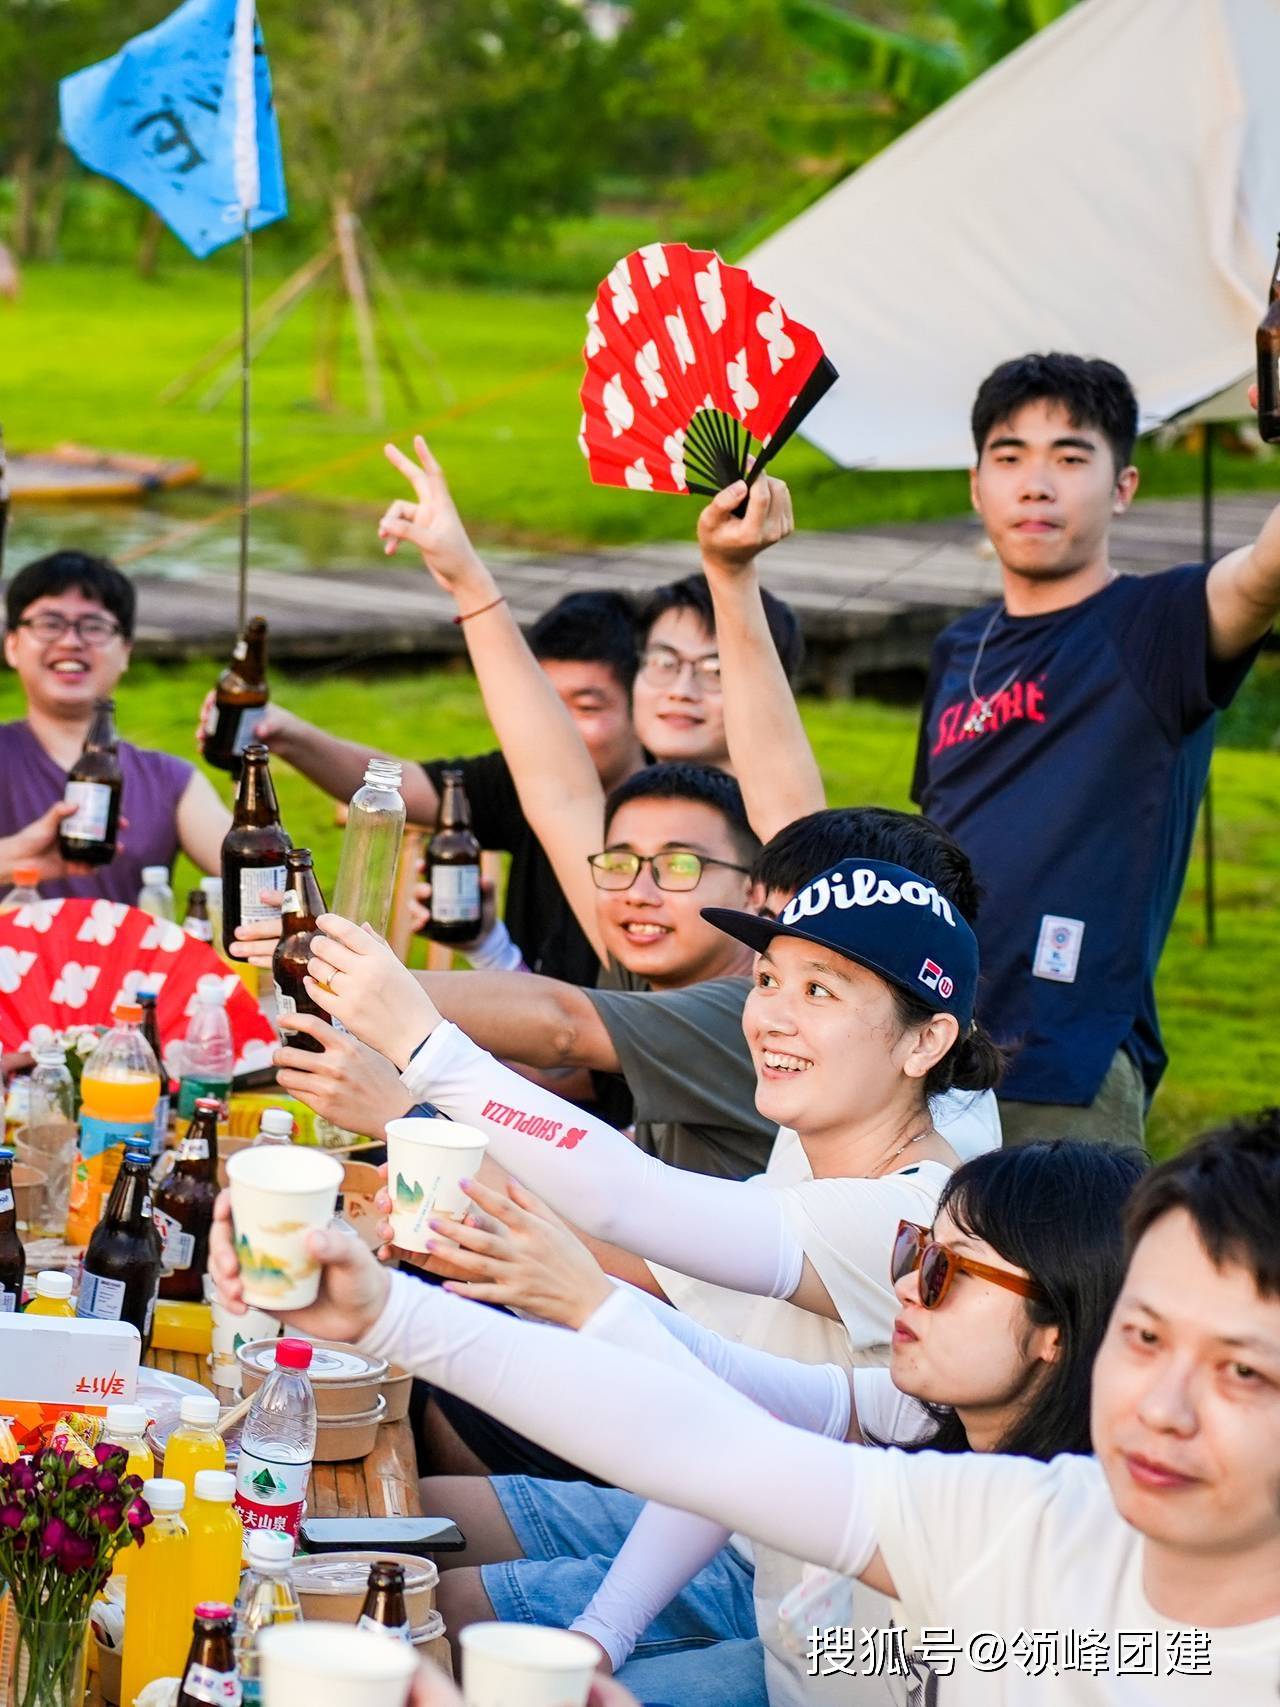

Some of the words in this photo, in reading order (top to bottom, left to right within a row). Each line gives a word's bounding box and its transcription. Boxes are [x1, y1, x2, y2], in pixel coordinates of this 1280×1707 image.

[782, 868, 956, 927] Wilson
[481, 1100, 563, 1141] SHOPLAZZA
[75, 1369, 125, 1399] 劲仔
